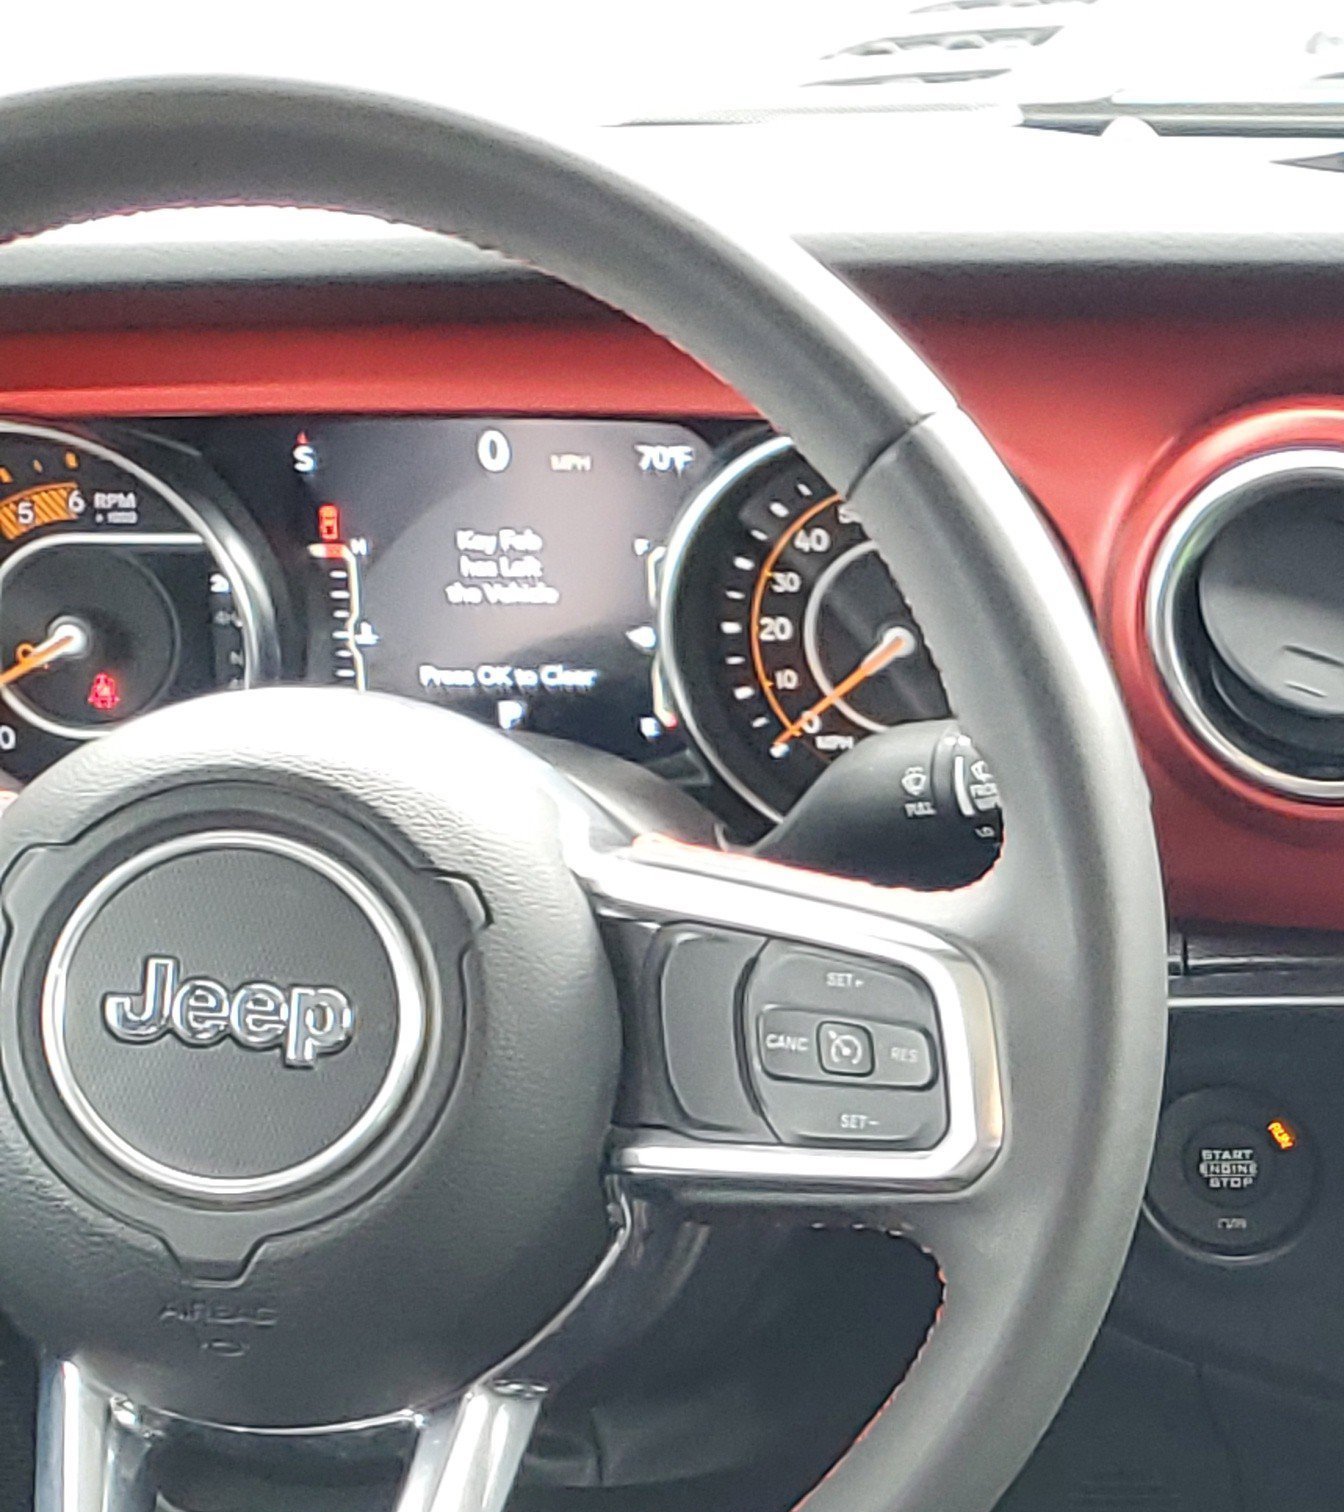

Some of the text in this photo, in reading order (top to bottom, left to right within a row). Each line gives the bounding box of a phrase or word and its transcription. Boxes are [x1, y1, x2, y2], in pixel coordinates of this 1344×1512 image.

[293, 446, 316, 473] S
[478, 429, 511, 472] 0
[68, 491, 86, 513] 6
[18, 502, 34, 524] 5
[794, 528, 831, 552] 40
[771, 573, 800, 592] 30
[759, 620, 793, 640] 20
[477, 666, 513, 686] OK
[775, 671, 797, 688] 10
[102, 955, 355, 1068] Jeep
[1202, 1150, 1252, 1159] START
[1201, 1163, 1258, 1174] ENGINE
[1210, 1177, 1253, 1188] STOP
